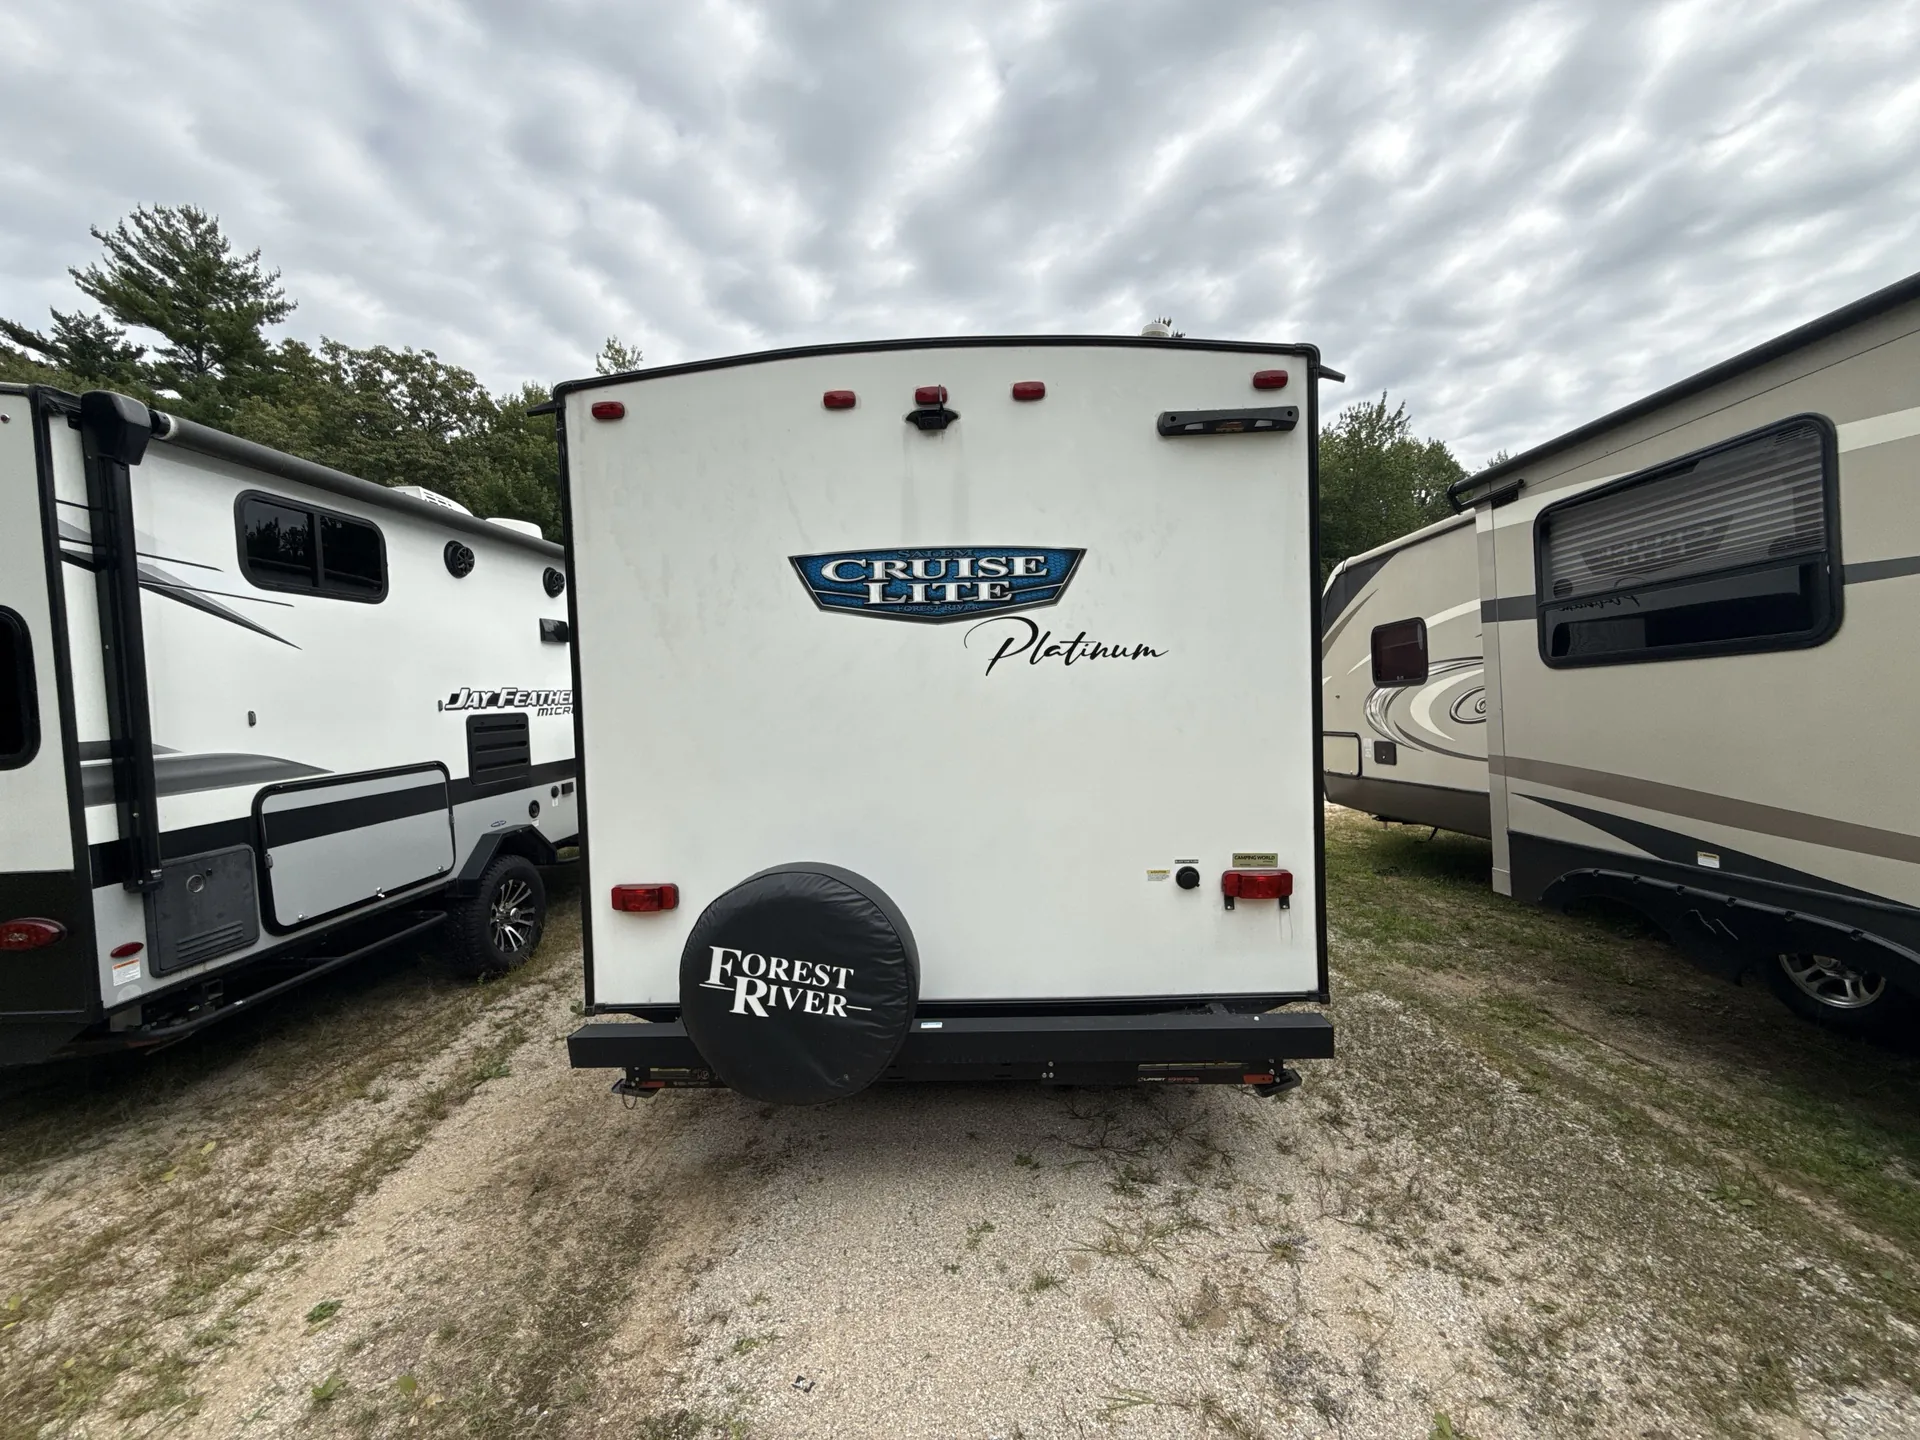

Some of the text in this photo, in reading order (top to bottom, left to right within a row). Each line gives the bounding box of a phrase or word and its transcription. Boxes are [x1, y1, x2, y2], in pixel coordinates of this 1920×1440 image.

[897, 549, 973, 558] SALEM
[820, 555, 1047, 582] CRUISE
[864, 582, 1012, 604] LITE
[943, 603, 980, 611] RIVER
[964, 616, 1169, 677] Platinum
[444, 687, 495, 711] JAY
[537, 707, 573, 716] MICR
[705, 946, 854, 988] FOREST
[729, 976, 847, 1017] RIVER
